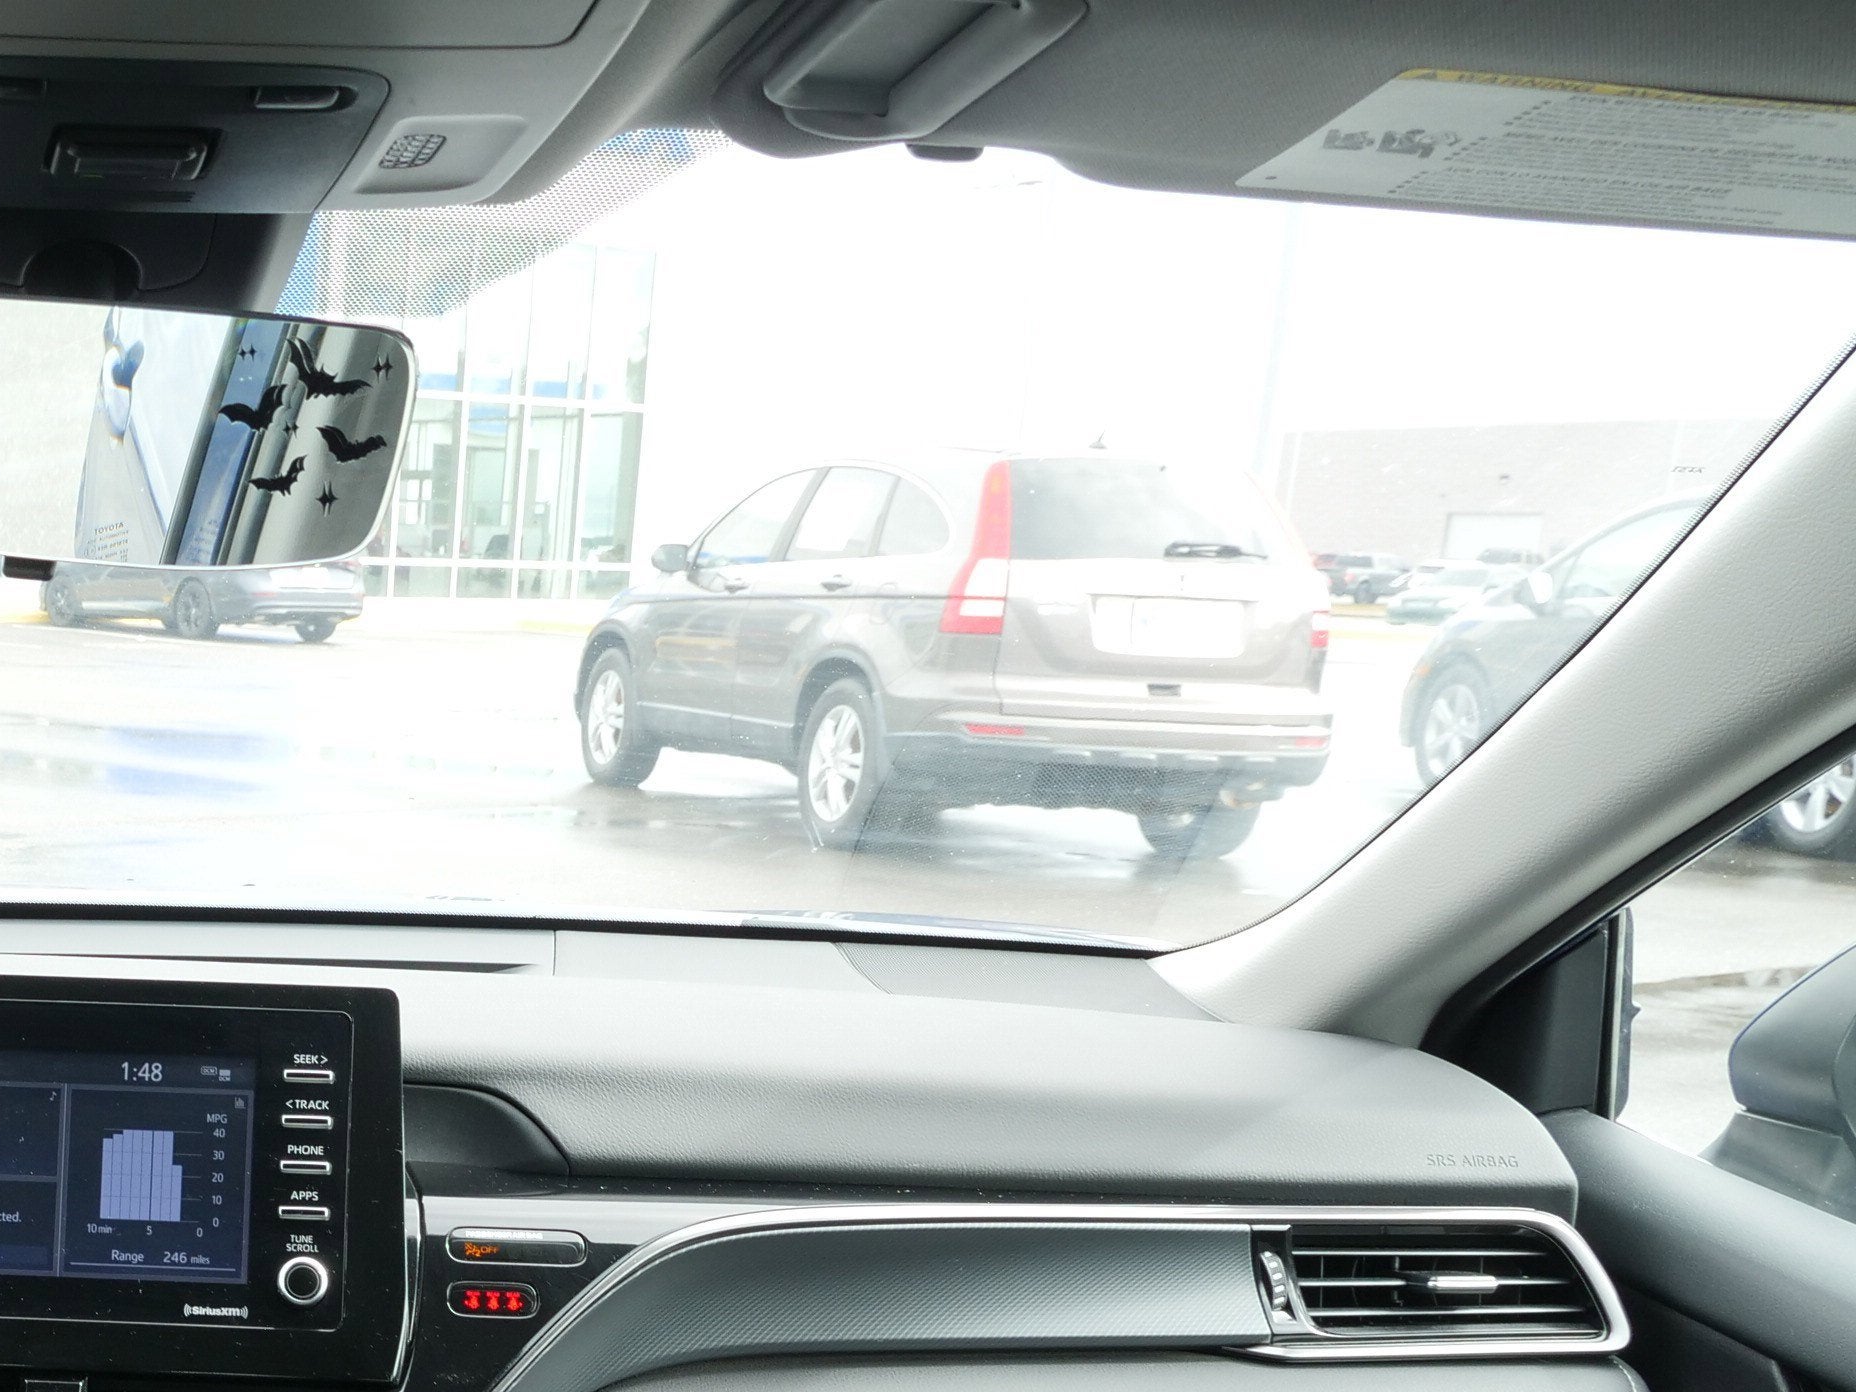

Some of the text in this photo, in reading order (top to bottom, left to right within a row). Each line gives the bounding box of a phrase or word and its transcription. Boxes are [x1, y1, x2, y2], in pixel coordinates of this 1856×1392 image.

[94, 522, 125, 535] TOYOTA
[294, 1054, 319, 1064] SEEK
[121, 1061, 163, 1082] 1:48
[295, 1100, 329, 1110] TRACK
[206, 1113, 228, 1124] MPG
[213, 1129, 226, 1138] 40
[287, 1145, 324, 1156] PHONE
[212, 1151, 225, 1161] 30
[1427, 1154, 1519, 1168] SRS AIRBAG
[211, 1173, 224, 1183] 20
[211, 1195, 223, 1205] 10
[291, 1191, 319, 1201] APPS
[213, 1217, 220, 1228] 0
[87, 1223, 113, 1234] 10 min
[146, 1226, 153, 1236] 5
[196, 1227, 203, 1238] 0
[290, 1234, 314, 1244] TUNE
[286, 1243, 319, 1253] SCROLL
[111, 1250, 210, 1265] Range 246 miles
